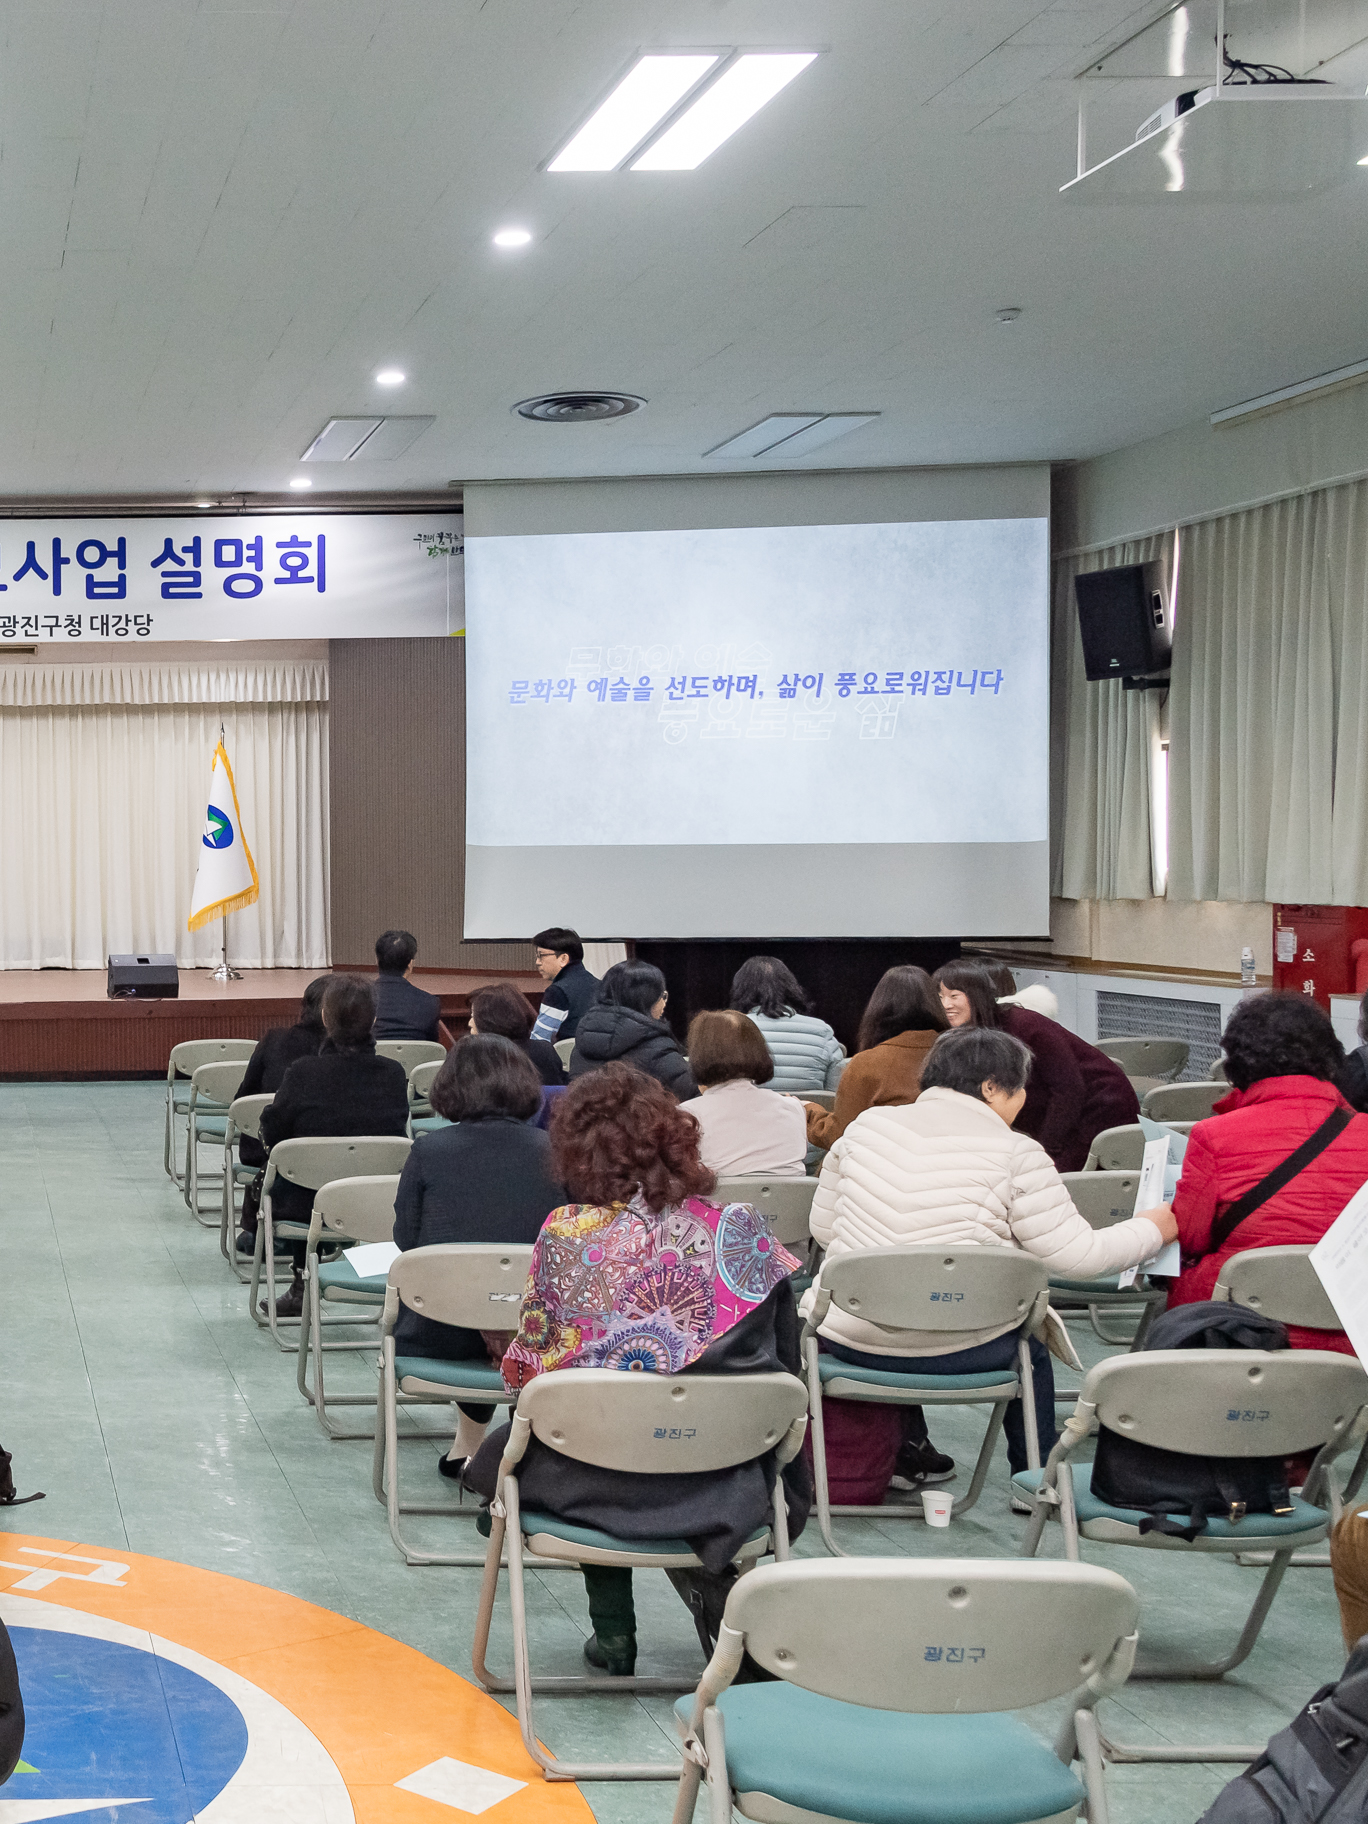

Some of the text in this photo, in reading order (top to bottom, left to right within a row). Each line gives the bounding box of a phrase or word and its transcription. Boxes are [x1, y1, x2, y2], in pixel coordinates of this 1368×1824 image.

[149, 534, 327, 600] 설명회
[89, 613, 154, 638] 대강당
[508, 668, 1005, 704] 문화와 예술을 선도하며, 삶이 풍요로워집니다
[1226, 1409, 1271, 1423] 광진구
[653, 1427, 697, 1440] 광진구
[923, 1646, 987, 1664] 광진구
